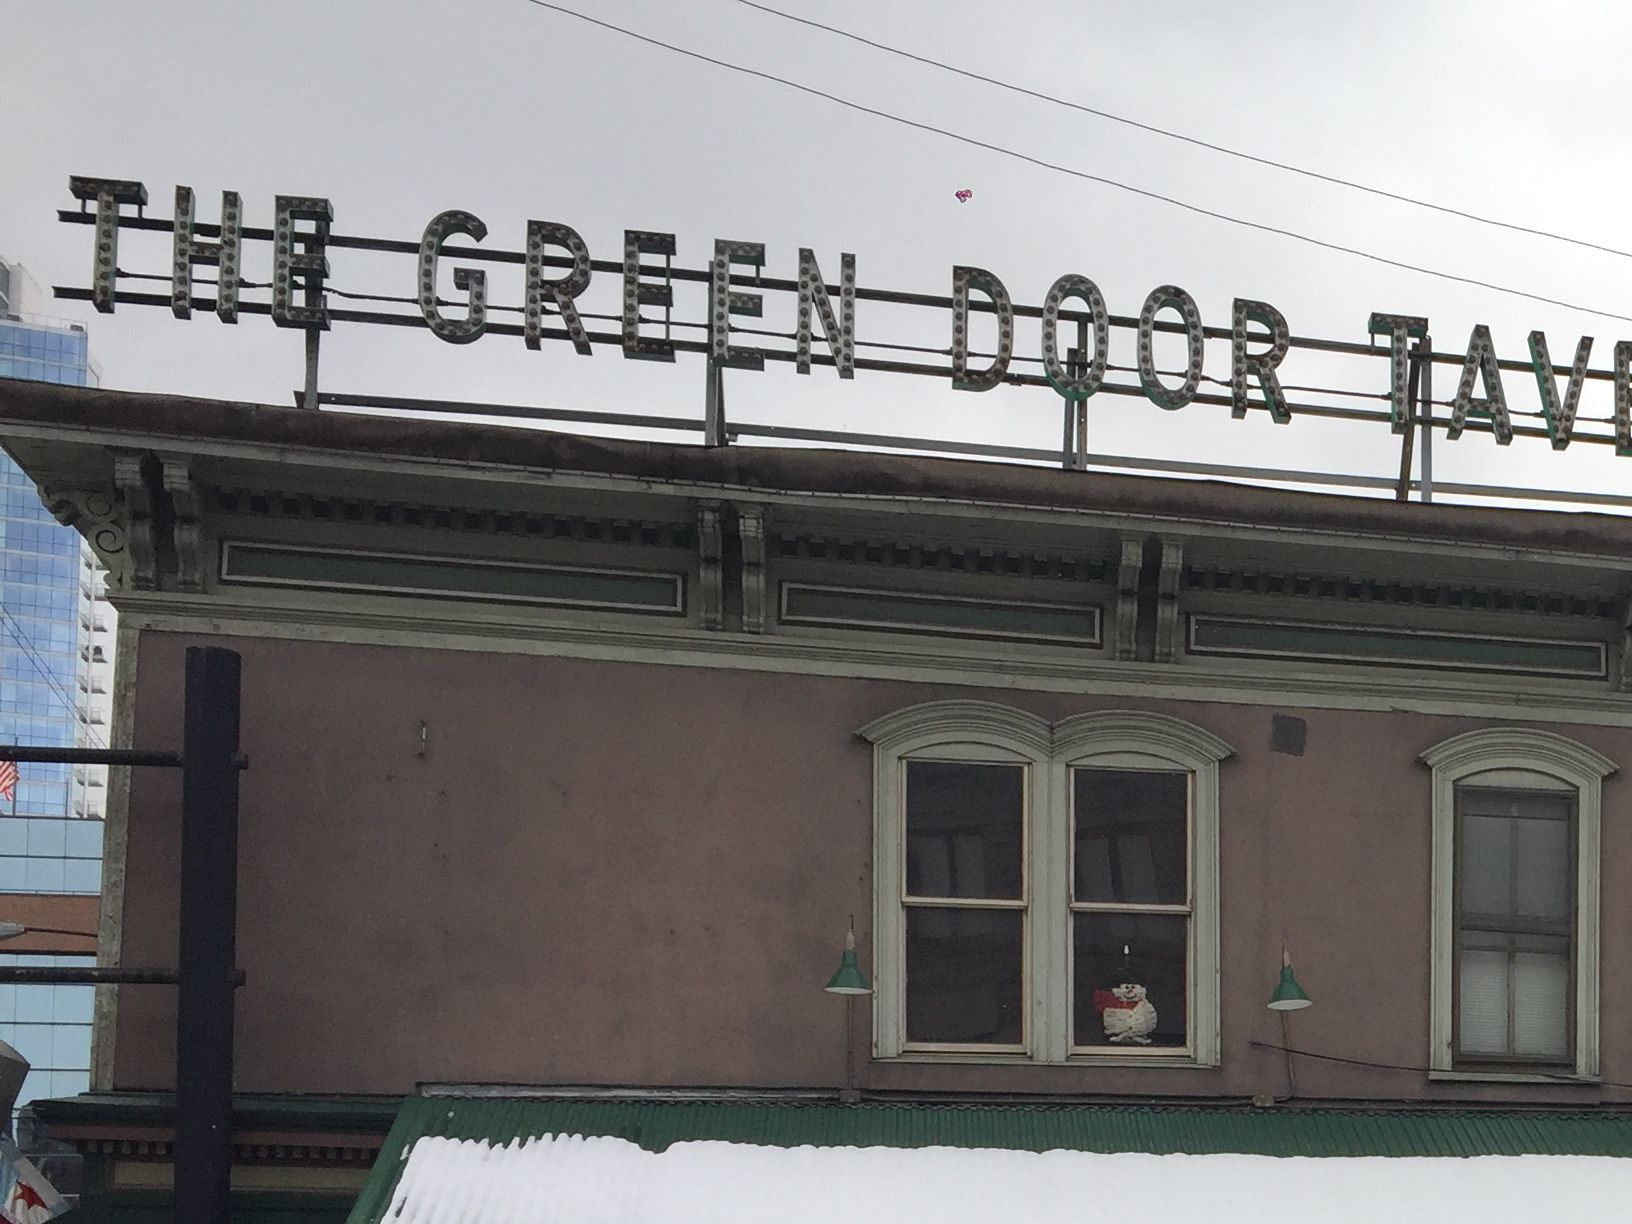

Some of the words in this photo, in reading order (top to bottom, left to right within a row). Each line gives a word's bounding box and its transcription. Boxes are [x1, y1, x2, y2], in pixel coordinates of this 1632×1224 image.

[69, 174, 334, 331] THE
[418, 209, 856, 380] GREEN
[951, 265, 1291, 425] DOOR
